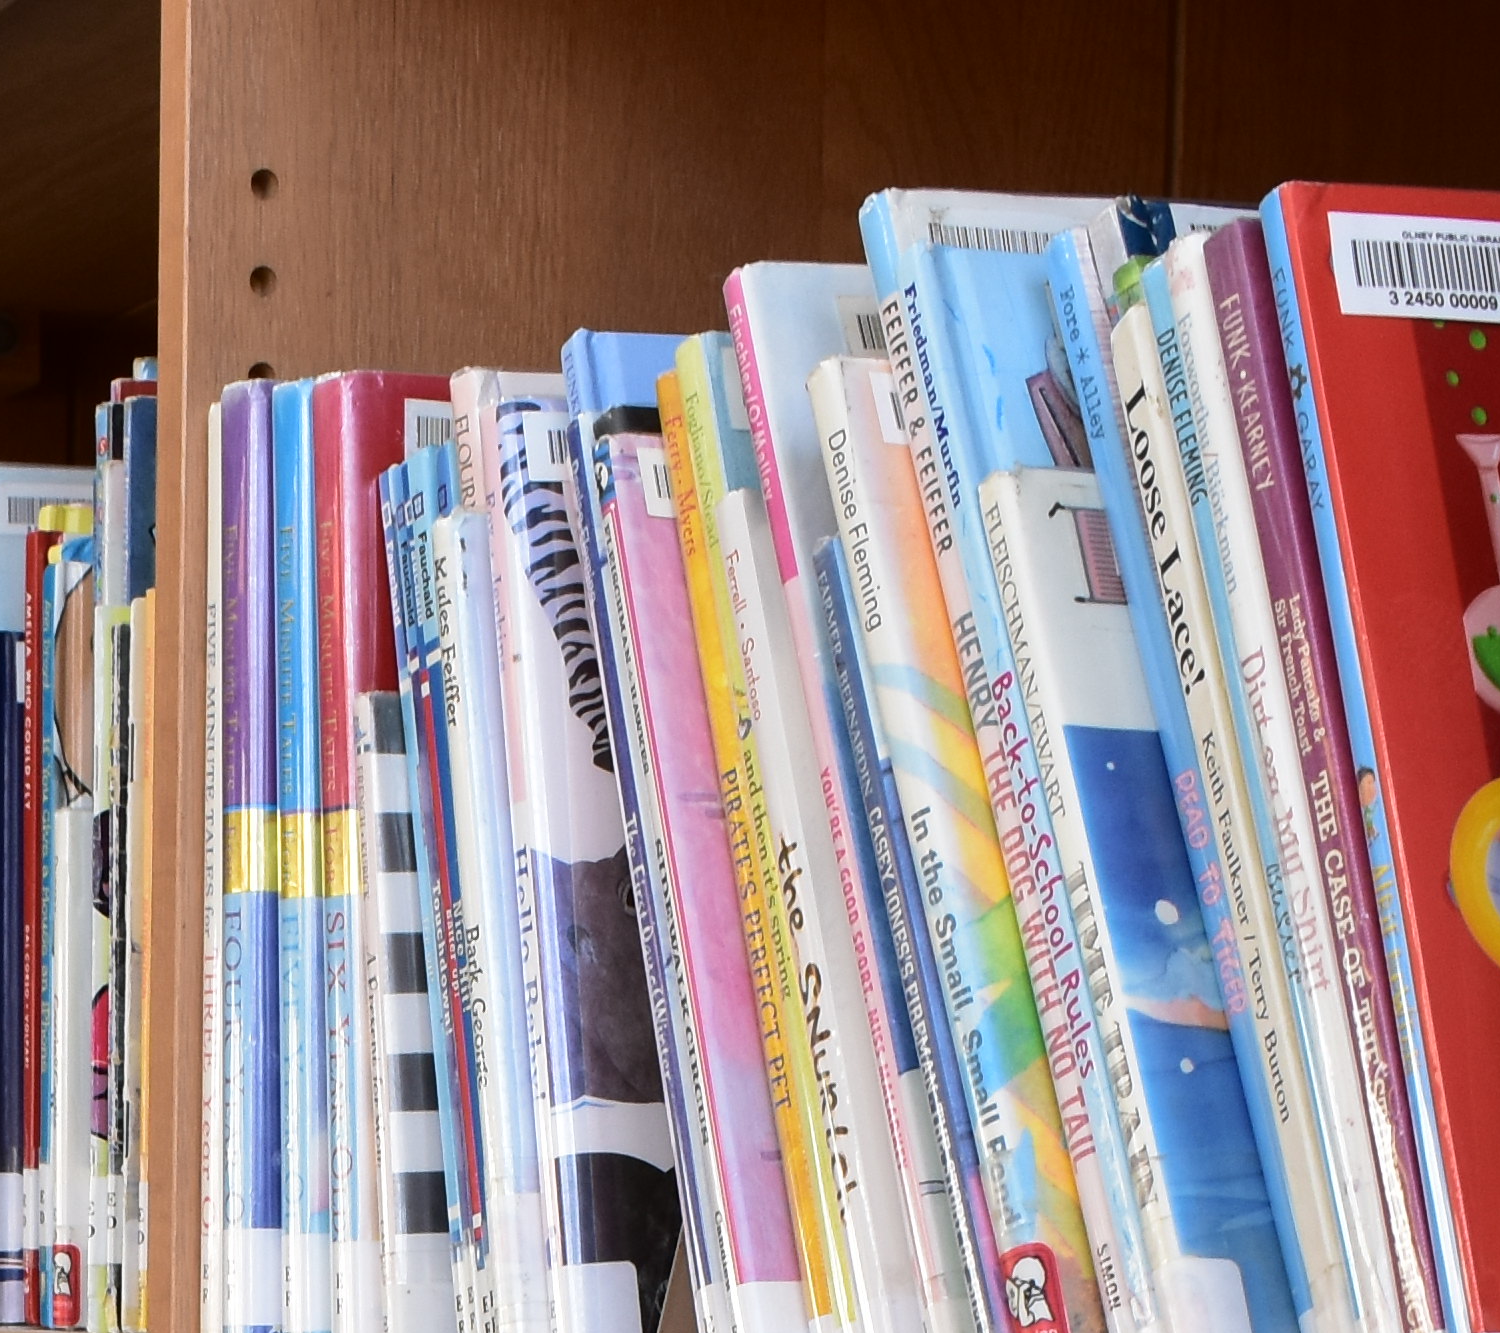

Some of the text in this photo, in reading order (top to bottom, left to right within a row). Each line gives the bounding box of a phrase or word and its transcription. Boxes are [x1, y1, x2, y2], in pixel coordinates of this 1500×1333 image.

[1389, 291, 1399, 304] 3
[1405, 292, 1443, 307] 2450
[1449, 294, 1497, 310] 00009
[1401, 232, 1432, 241] OLNEY
[1435, 233, 1468, 243] PUBLIC
[880, 300, 957, 557] FEIFFER & FEIFFER
[901, 281, 965, 510] Friedman/Murfin
[1154, 327, 1210, 507] DENISE FLEMING
[1217, 291, 1277, 492] FUNK KEARNEY
[417, 531, 433, 618] Fauchald
[825, 428, 887, 632] Denise Fleming
[1120, 378, 1209, 698] Loose Lace!
[724, 549, 766, 720] Ferrell Santoso
[982, 501, 1066, 820] FLEISCHMAN/EWART
[742, 749, 795, 1000] and then it's spring
[907, 806, 935, 838] In
[916, 845, 950, 906] the
[950, 610, 1098, 1168] HENRY THE DOG WITH NO TAIL
[989, 668, 1103, 1079] Back-to-School Rules
[718, 769, 792, 1111] PIRATE'S PERFECT PET
[929, 914, 976, 1024] Small,
[1199, 729, 1228, 803] Keith
[1215, 808, 1252, 926] Faulkner
[1243, 948, 1273, 1022] Terry
[1261, 1030, 1294, 1124] Burton
[957, 1028, 1000, 1127] Small
[1063, 860, 1160, 1210] TIME TRAIN
[1095, 1243, 1121, 1310] SIMON
